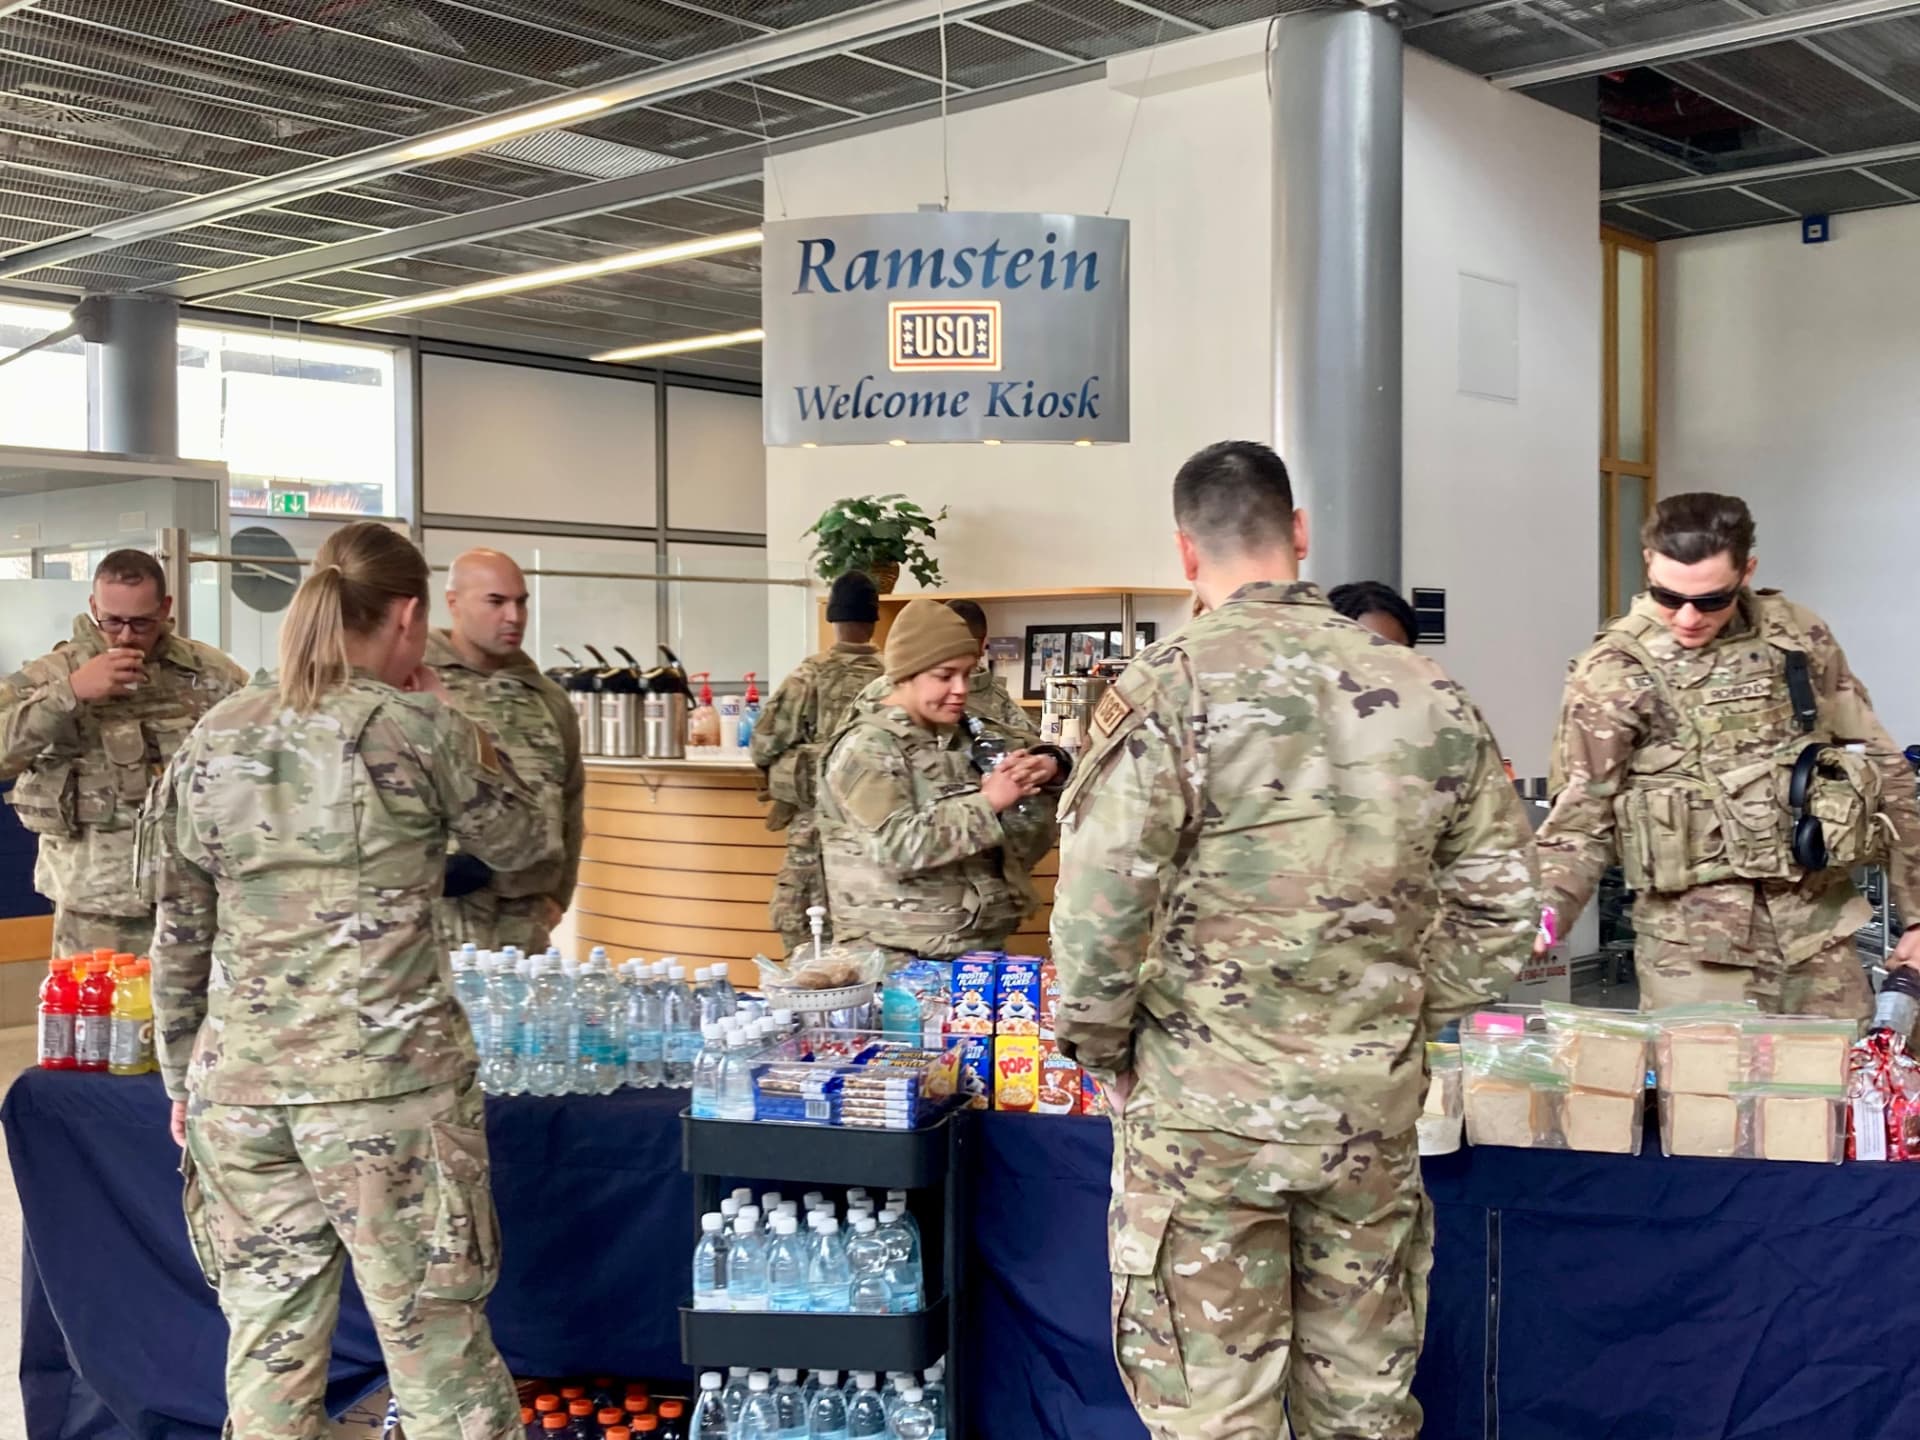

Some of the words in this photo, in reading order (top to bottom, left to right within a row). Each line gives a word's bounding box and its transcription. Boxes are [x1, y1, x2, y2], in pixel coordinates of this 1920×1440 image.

[792, 232, 1100, 295] Ramstein
[915, 316, 974, 357] USO
[795, 375, 970, 420] Welcome
[984, 376, 1100, 420] Kiosk
[957, 972, 989, 981] FROSTED
[959, 979, 985, 987] FLAKES
[1001, 972, 1033, 981] FROSTED
[1003, 979, 1030, 987] FLAKES
[998, 1057, 1033, 1079] POPS
